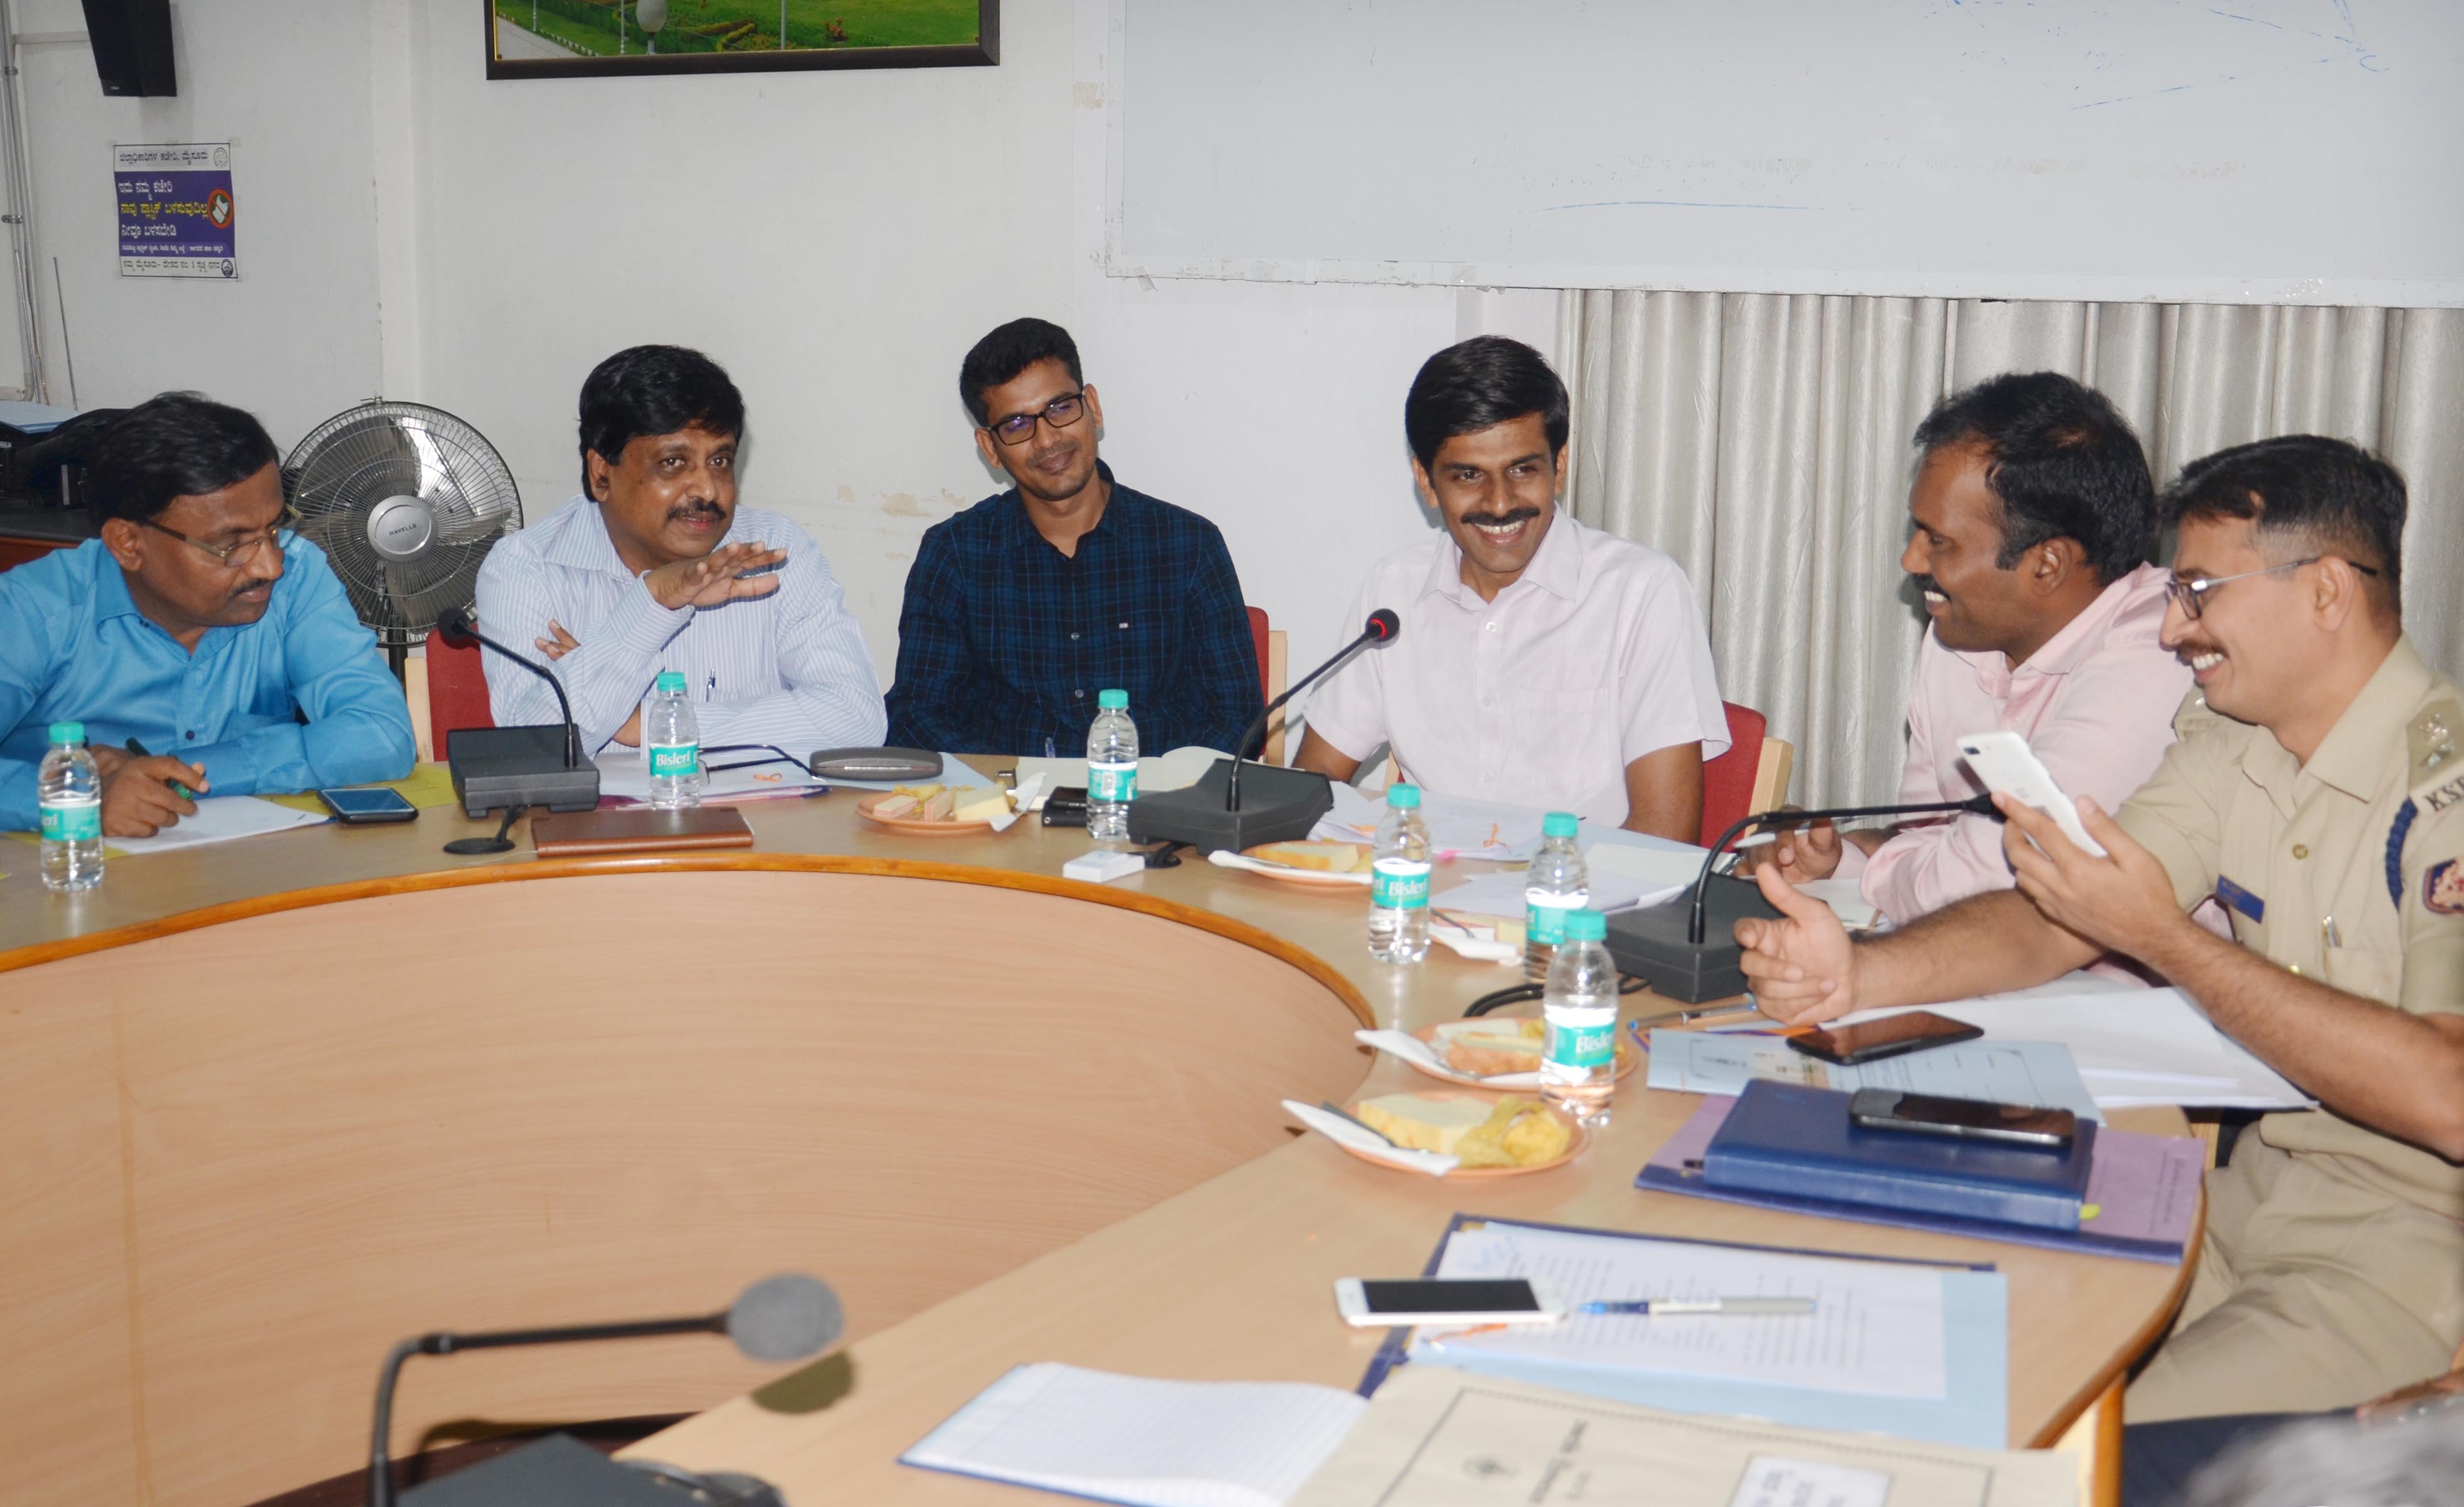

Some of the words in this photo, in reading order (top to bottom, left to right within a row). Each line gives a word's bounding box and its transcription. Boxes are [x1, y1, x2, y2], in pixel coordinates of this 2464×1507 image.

[135, 181, 153, 200] ನಮ್ಮ
[153, 180, 173, 193] ಕಚೇರಿ
[121, 202, 137, 217] ನಾವು
[144, 223, 176, 236] ಬಳಸಬೇಡಿ
[389, 523, 417, 536] HAVELLS
[656, 750, 691, 766] Bisleri
